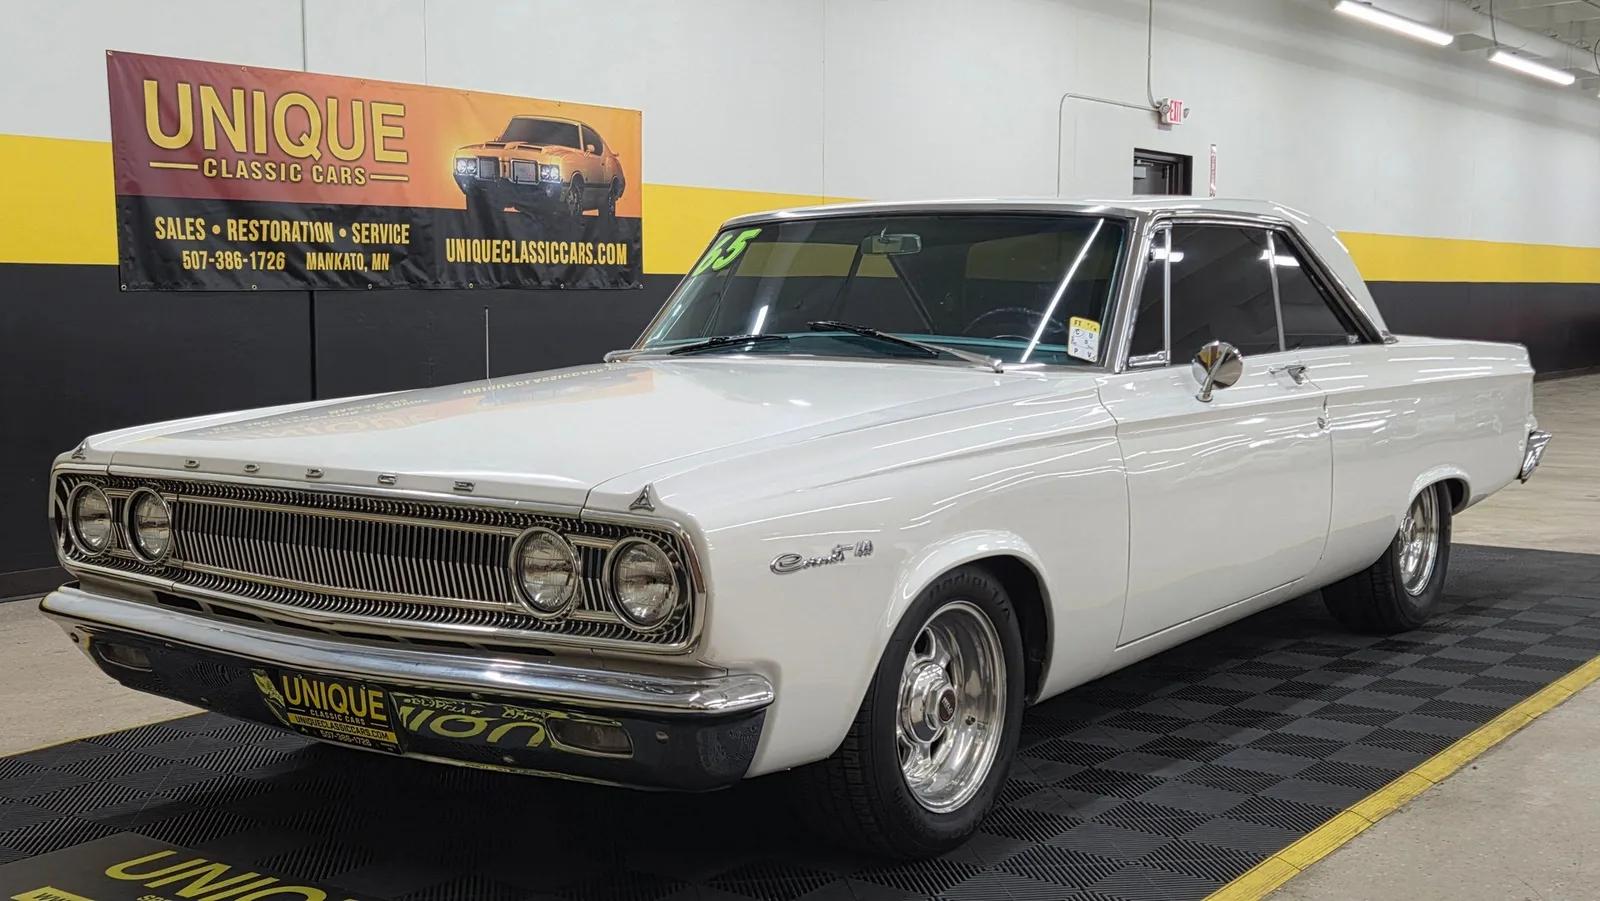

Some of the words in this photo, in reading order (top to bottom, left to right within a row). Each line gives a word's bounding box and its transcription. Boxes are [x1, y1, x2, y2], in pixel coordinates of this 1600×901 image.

[143, 79, 409, 163] UNIQUE
[203, 158, 302, 183] CLASSIC
[312, 165, 367, 186] CARS
[154, 216, 207, 241] SALES
[227, 219, 335, 244] RESTORATION
[352, 222, 410, 245] SERVICE
[182, 250, 286, 271] 507-386-1726
[306, 252, 368, 273] MANKATO,
[371, 253, 390, 271] MN
[445, 238, 628, 266] UNIQUECLASSICCARS.COM
[692, 228, 762, 277] 65
[282, 675, 387, 721] UNIQUE
[310, 709, 343, 721] CLASSIC
[345, 715, 366, 726] CARS
